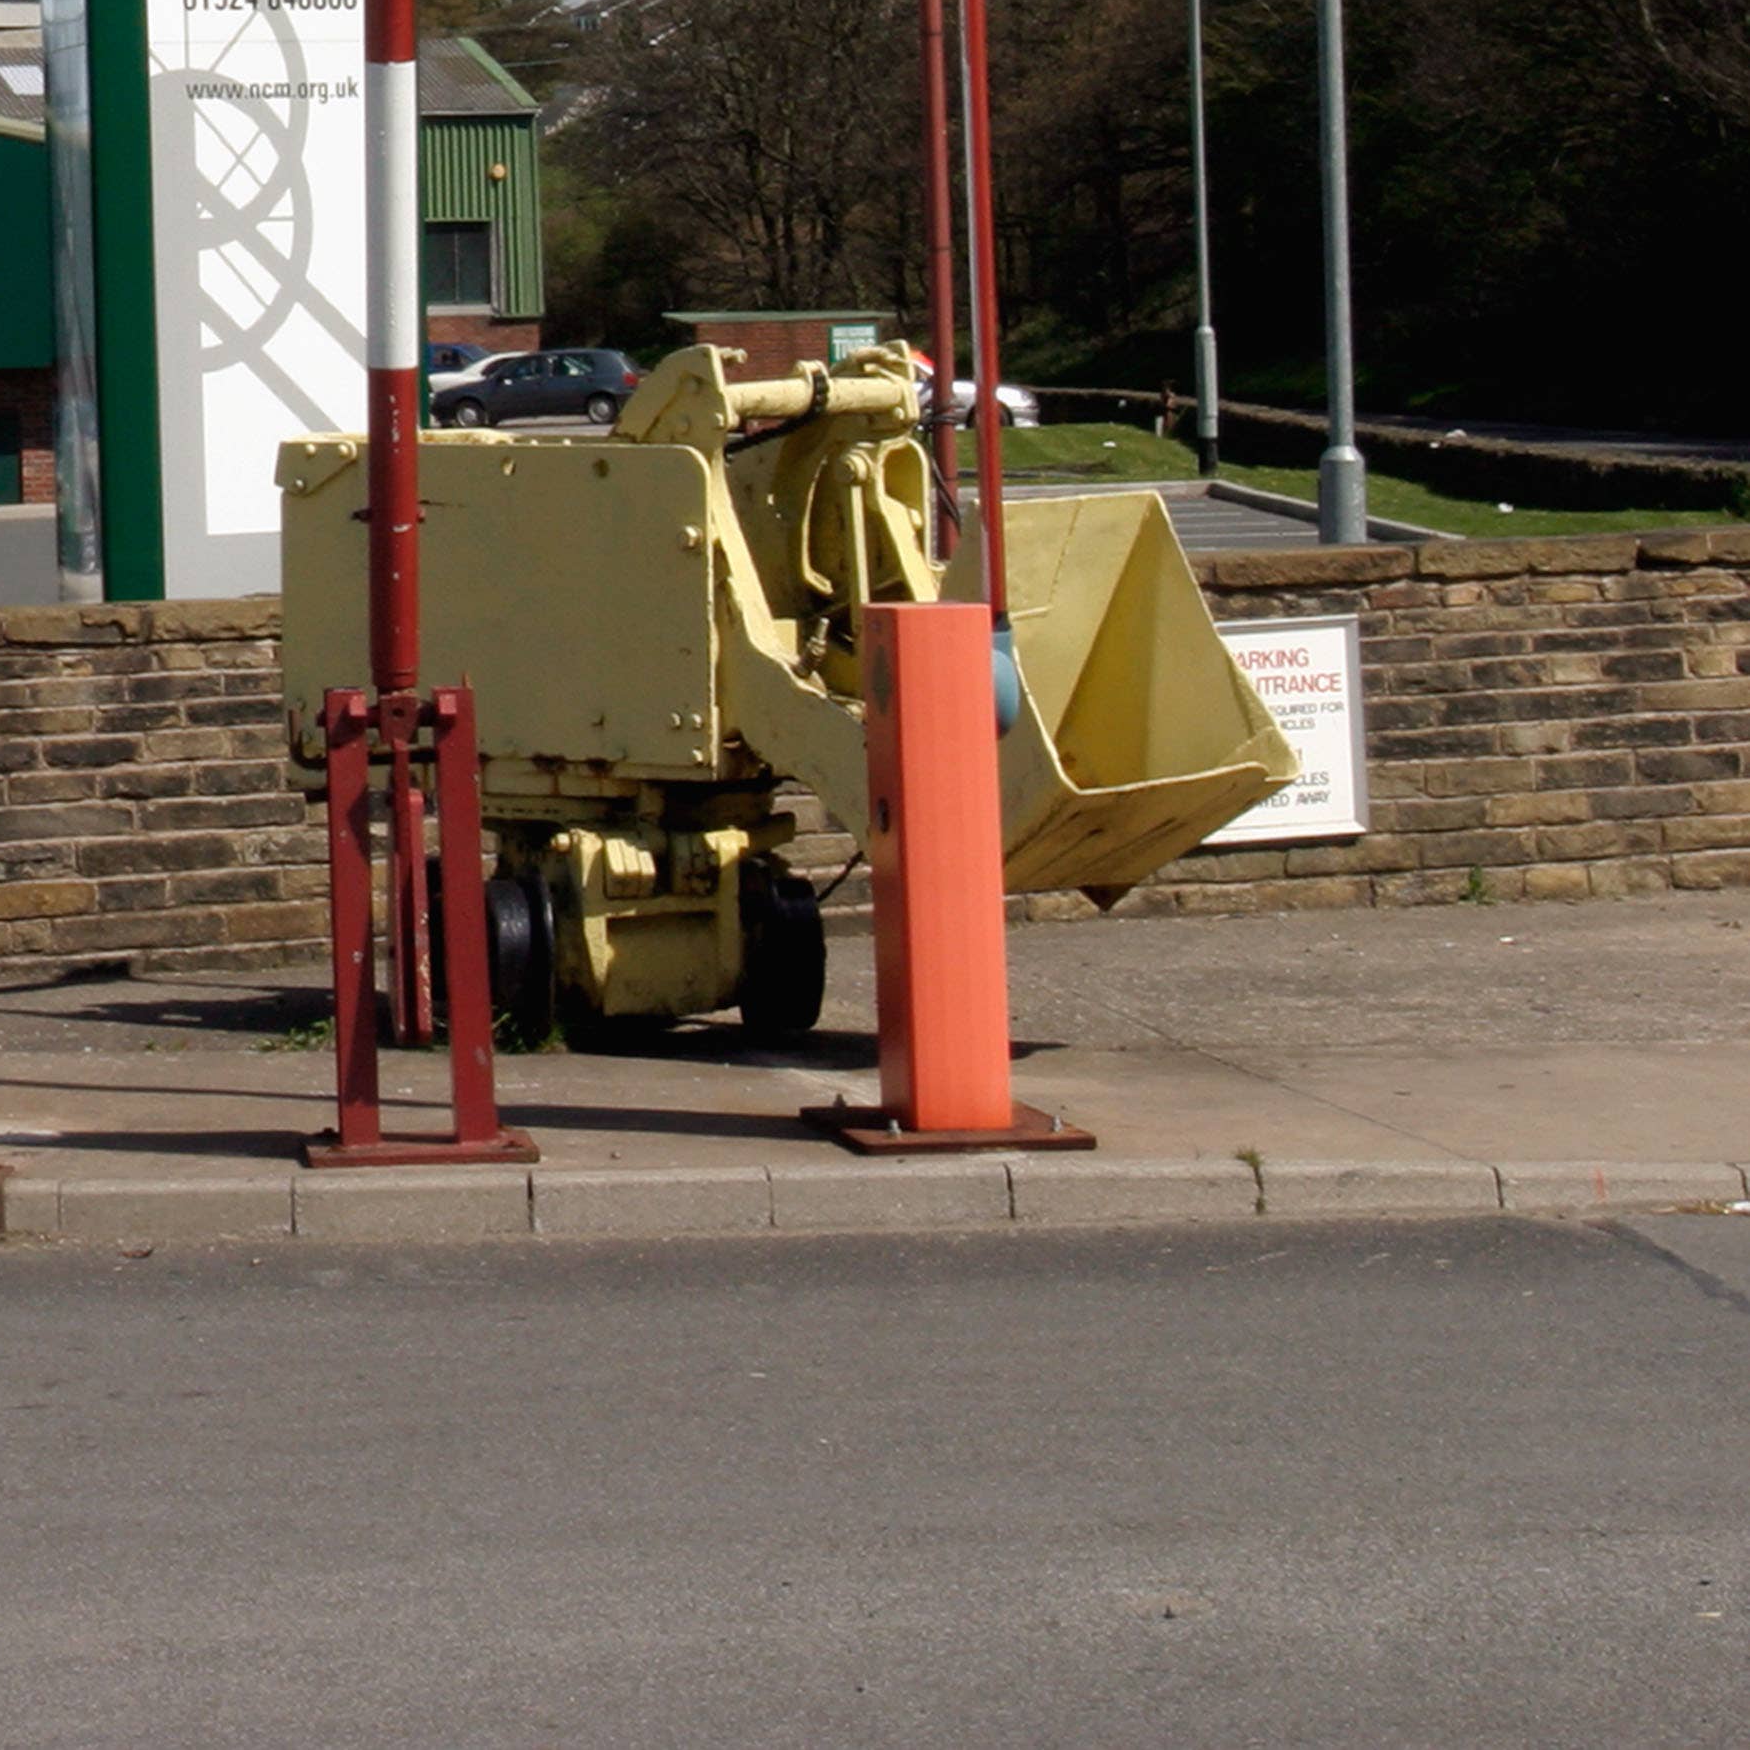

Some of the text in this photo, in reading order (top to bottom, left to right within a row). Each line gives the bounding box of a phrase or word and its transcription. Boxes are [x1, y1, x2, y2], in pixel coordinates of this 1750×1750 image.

[186, 80, 358, 104] www.ncm.org.uk
[1234, 648, 1309, 669] ARKING
[1320, 702, 1345, 713] FOR
